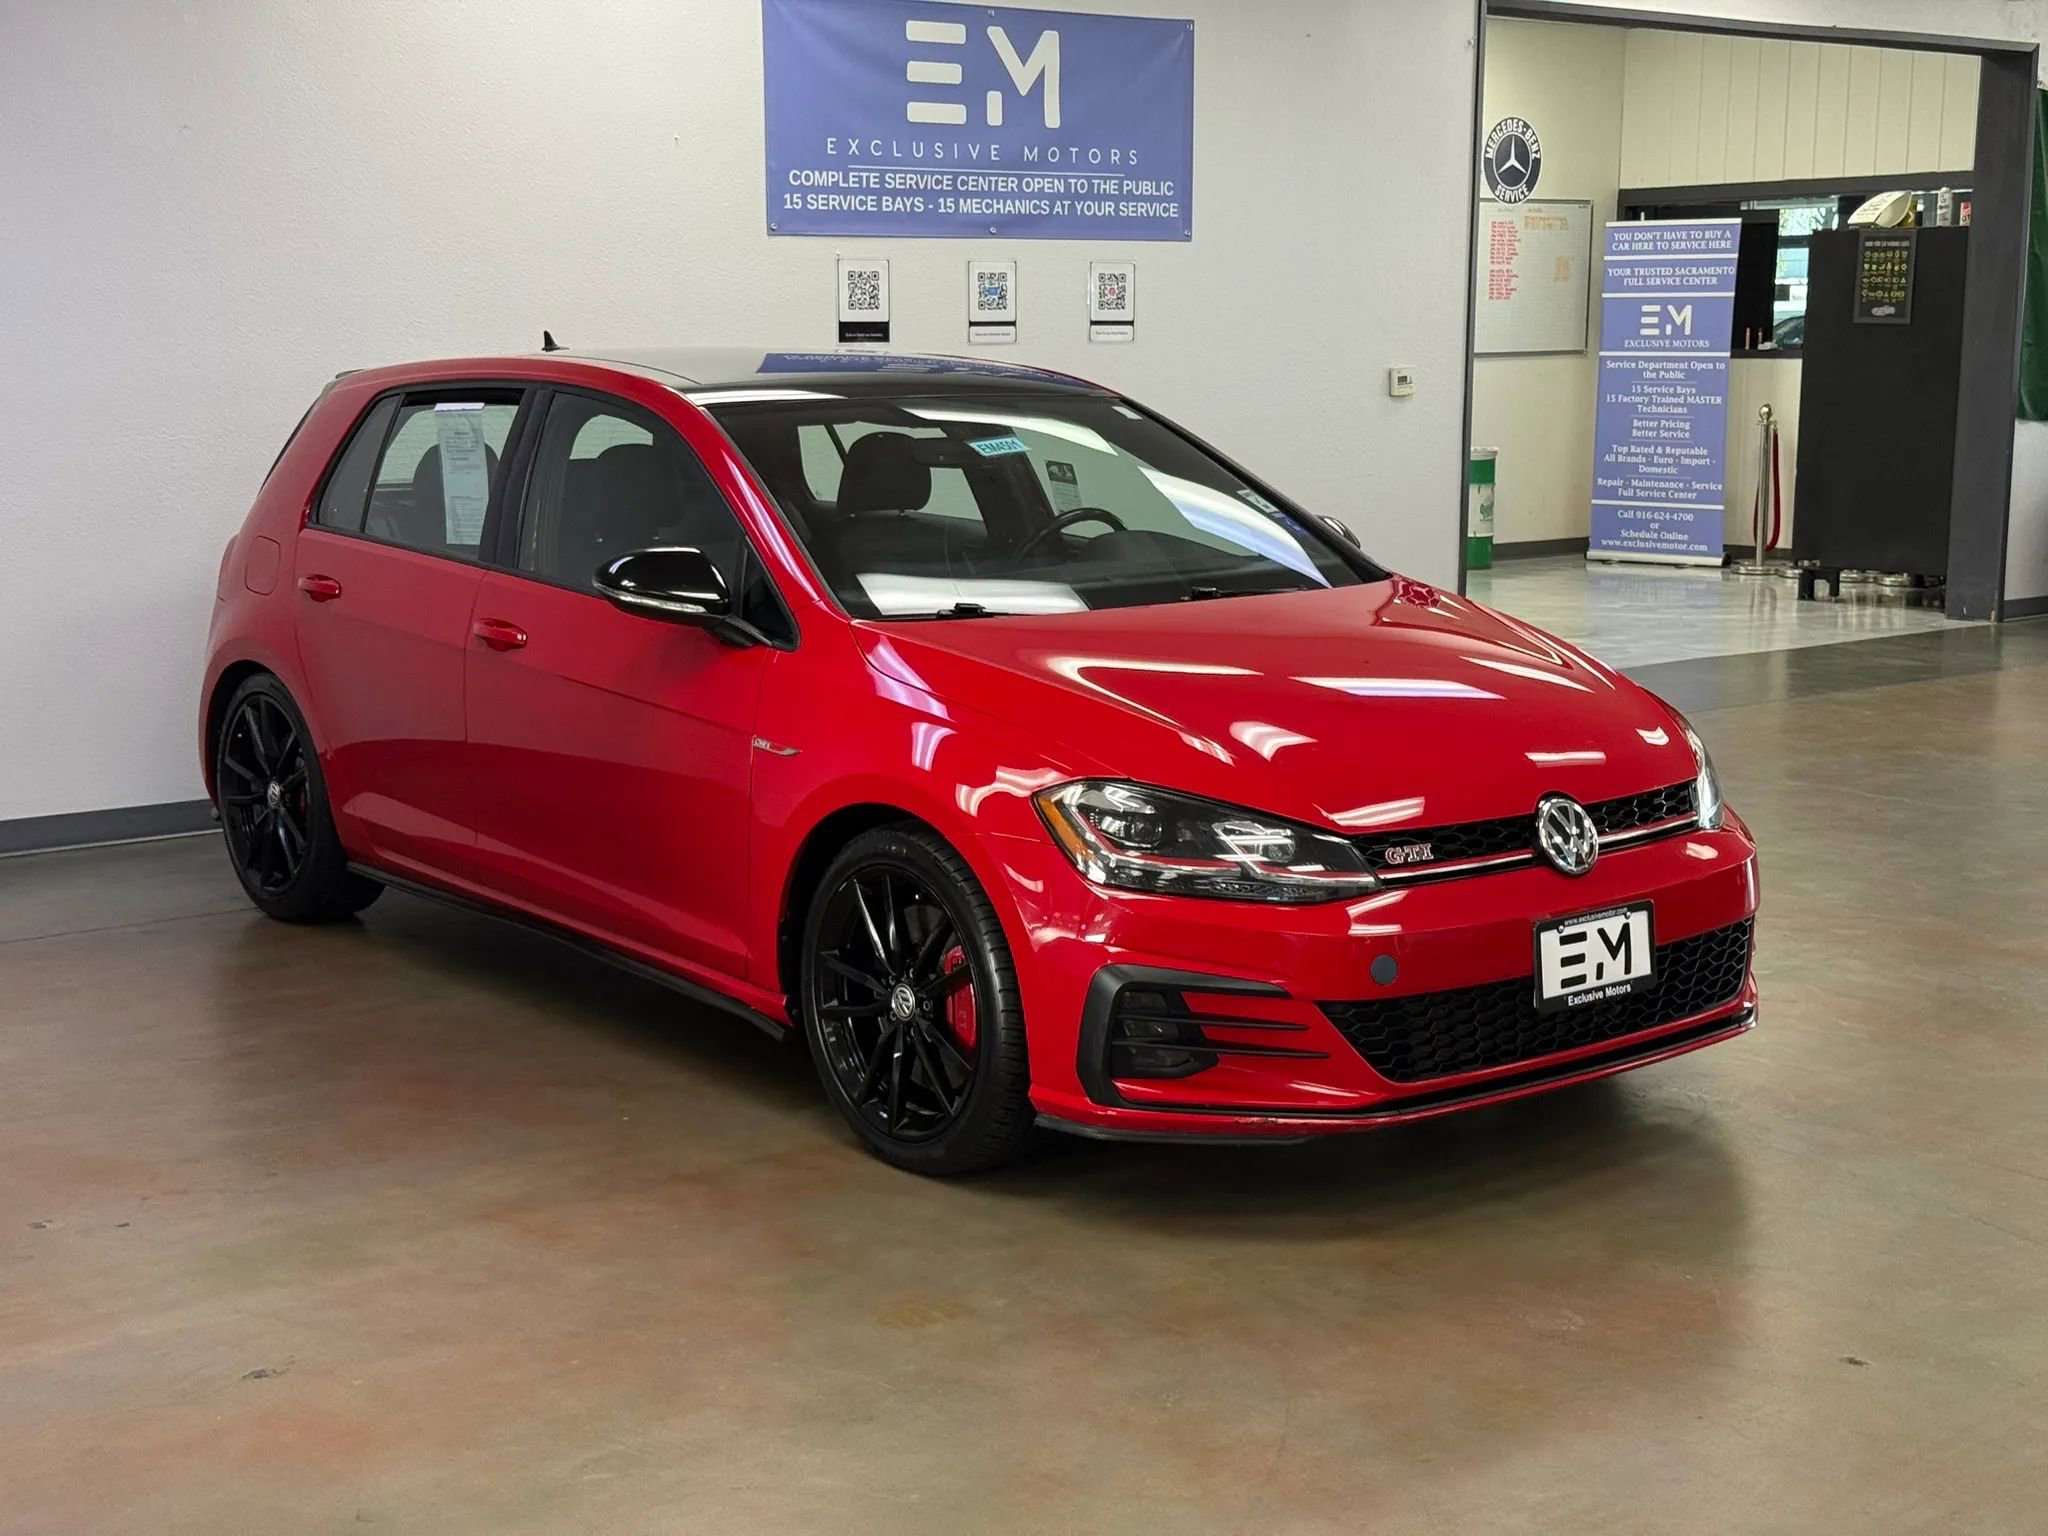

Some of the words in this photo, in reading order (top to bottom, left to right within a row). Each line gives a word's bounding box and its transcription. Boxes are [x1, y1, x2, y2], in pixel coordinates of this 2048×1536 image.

[906, 20, 1060, 128] EM
[1485, 118, 1541, 160] MERCEDES-BENZ
[827, 138, 1000, 161] EXCLUSIVE
[1024, 146, 1137, 165] MOTORS
[789, 170, 880, 188] COMPLETE
[885, 173, 953, 190] SERVICE
[957, 176, 1018, 192] CENTER
[1022, 178, 1064, 193] OPEN
[1068, 179, 1088, 194] TO
[1092, 180, 1119, 194] THE
[1123, 181, 1174, 196] PUBLIC
[1494, 184, 1530, 203] SERVICE
[784, 193, 802, 209] 15
[807, 194, 878, 211] SERVICE
[882, 196, 924, 212] BAYS
[938, 198, 955, 213] 15
[959, 198, 1050, 215] MECHANICS
[1053, 201, 1071, 215] AT
[1074, 201, 1115, 216] YOUR
[1119, 202, 1179, 217] SERVICE
[1614, 232, 1632, 241] YOU
[1634, 231, 1661, 241] DON'T
[1663, 231, 1687, 240] HAVE
[1689, 230, 1703, 239] TO
[1705, 230, 1722, 239] BUY
[1724, 230, 1731, 238] A
[1612, 242, 1630, 251] CAR
[1632, 242, 1654, 250] HERE
[1656, 241, 1669, 250] TO
[1671, 241, 1707, 250] SERVICE
[1708, 240, 1732, 249] HERE
[1608, 268, 1631, 277] YOUR
[1634, 267, 1672, 276] TRUSTED
[1674, 266, 1735, 275] SACRAMENTO
[1624, 277, 1645, 286] FULL
[1646, 277, 1681, 286] SERVICE
[1683, 277, 1718, 285] CENTER
[1640, 304, 1692, 336] EM
[1624, 339, 1671, 348] EXCLUSIVE
[1672, 339, 1710, 348] MOTORS
[1606, 361, 1636, 369] Service
[1638, 361, 1688, 371] Department
[1690, 361, 1713, 371] Open
[1715, 362, 1725, 370] to
[1643, 371, 1657, 379] the
[1659, 371, 1686, 379] Public
[1631, 385, 1641, 393] 15
[1643, 385, 1675, 394] Service
[1676, 386, 1696, 396] Bays
[1606, 394, 1616, 402] 15
[1618, 394, 1650, 405] Factory
[1652, 395, 1685, 403] Trained
[1687, 396, 1722, 404] MASTER
[1637, 405, 1688, 414] Technicians
[1633, 419, 1658, 428] Better
[1660, 420, 1690, 430] Pricing
[1632, 429, 1657, 437] Better
[1659, 429, 1690, 438] Service
[1612, 445, 1628, 455] Top
[1631, 445, 1654, 454] Rated
[1656, 446, 1663, 454] &
[1665, 446, 1708, 457] Reputable
[1604, 454, 1616, 462] All
[1617, 455, 1646, 463] Brands
[1654, 456, 1673, 464] Euro
[1680, 456, 1710, 466] Import
[1639, 465, 1678, 474] Domestic
[1597, 478, 1624, 488] Repair
[1631, 480, 1683, 489] Maintenance
[1691, 481, 1722, 490] Service
[1618, 488, 1634, 496] Full
[1636, 489, 1666, 498] Service
[1668, 490, 1697, 499] Center
[1617, 510, 1634, 519] Call
[1636, 511, 1694, 521] 916-624-4700
[1621, 529, 1657, 539] Schedule
[1660, 532, 1688, 540] Online
[1601, 538, 1708, 551] www.exclusivemotor.com
[1385, 843, 1434, 864] GTI
[1564, 907, 1628, 926] www.exclusivemotor.com
[1559, 922, 1632, 989] EM
[1568, 990, 1604, 1006] Exclusive
[1606, 983, 1631, 998] Motors
